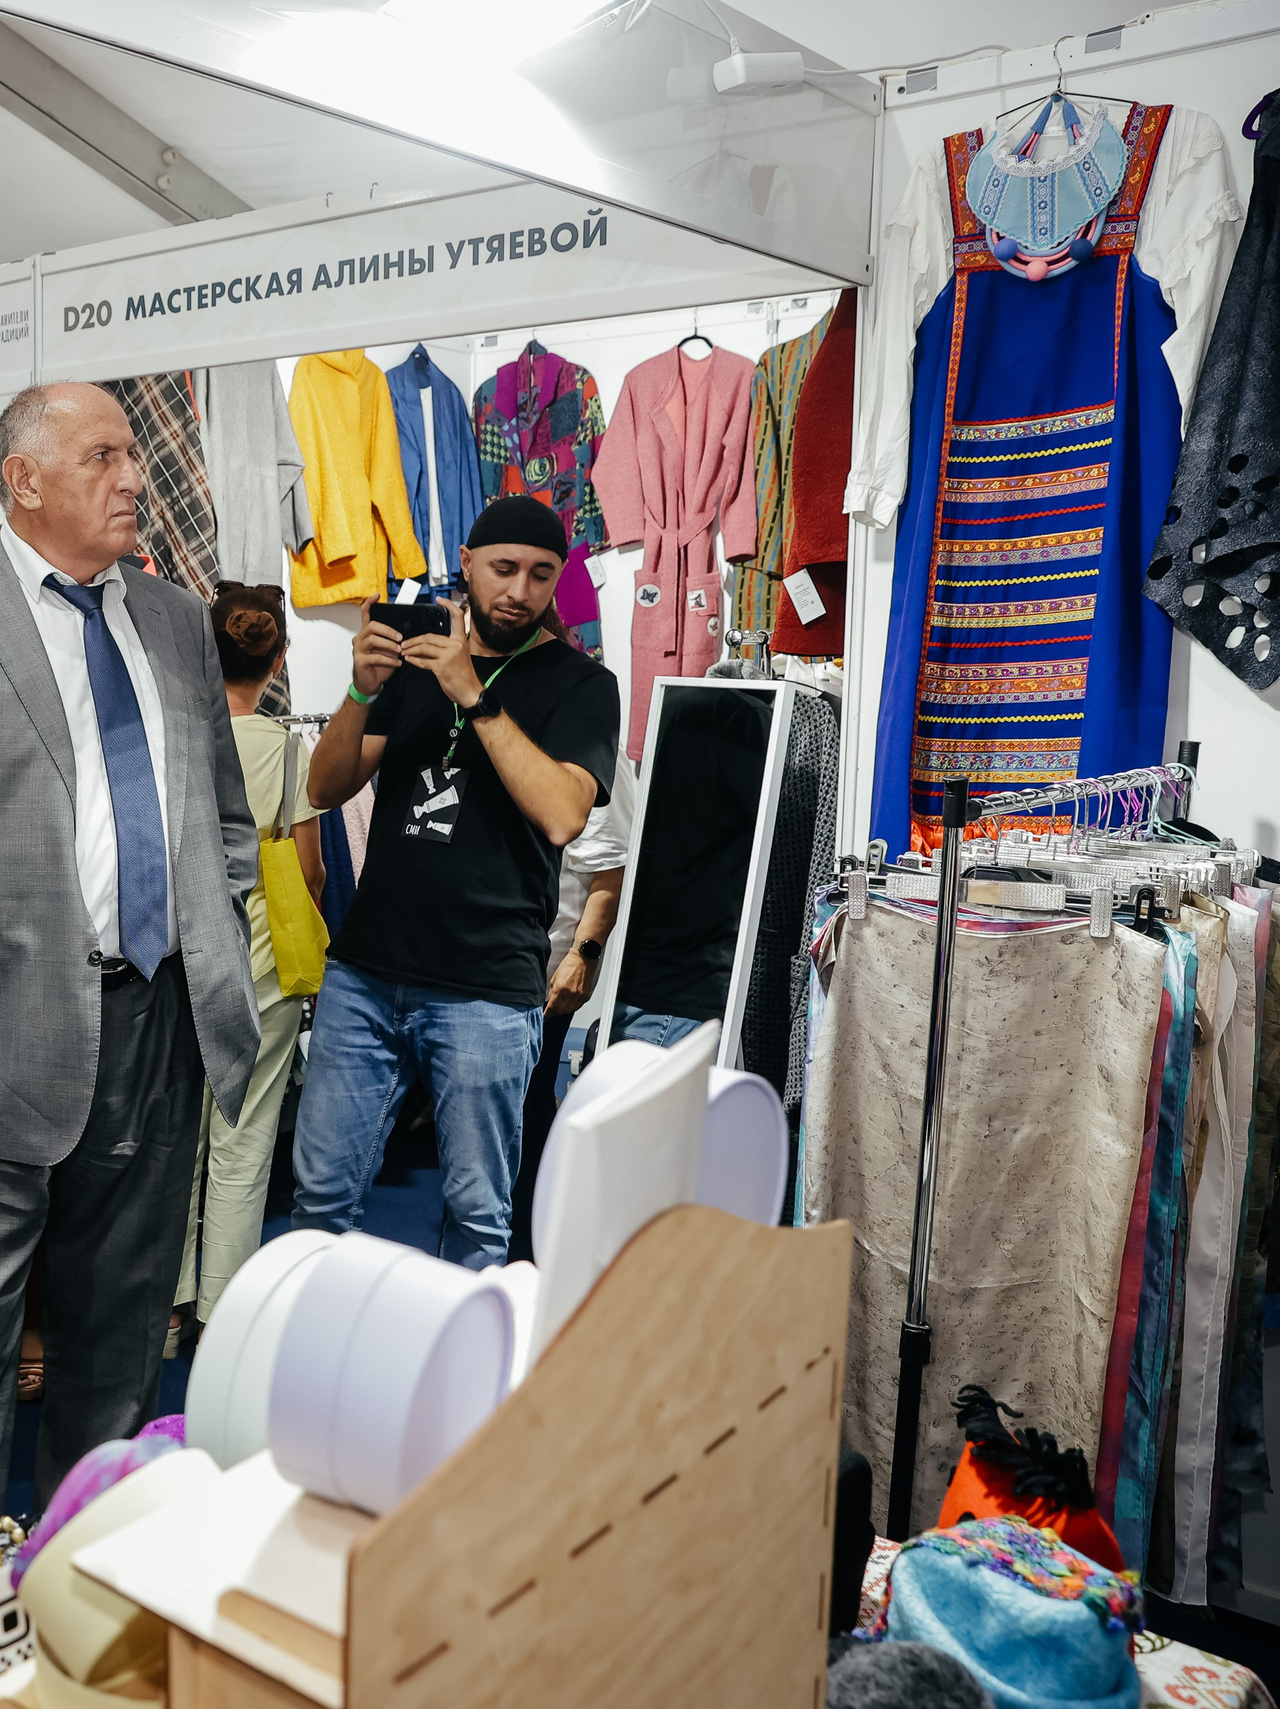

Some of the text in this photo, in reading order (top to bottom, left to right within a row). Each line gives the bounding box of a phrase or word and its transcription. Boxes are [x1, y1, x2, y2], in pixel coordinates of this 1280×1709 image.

[63, 207, 608, 332] D20 МАСТЕРСКАЯ АЛИНЫ УТЯЕВОЙ
